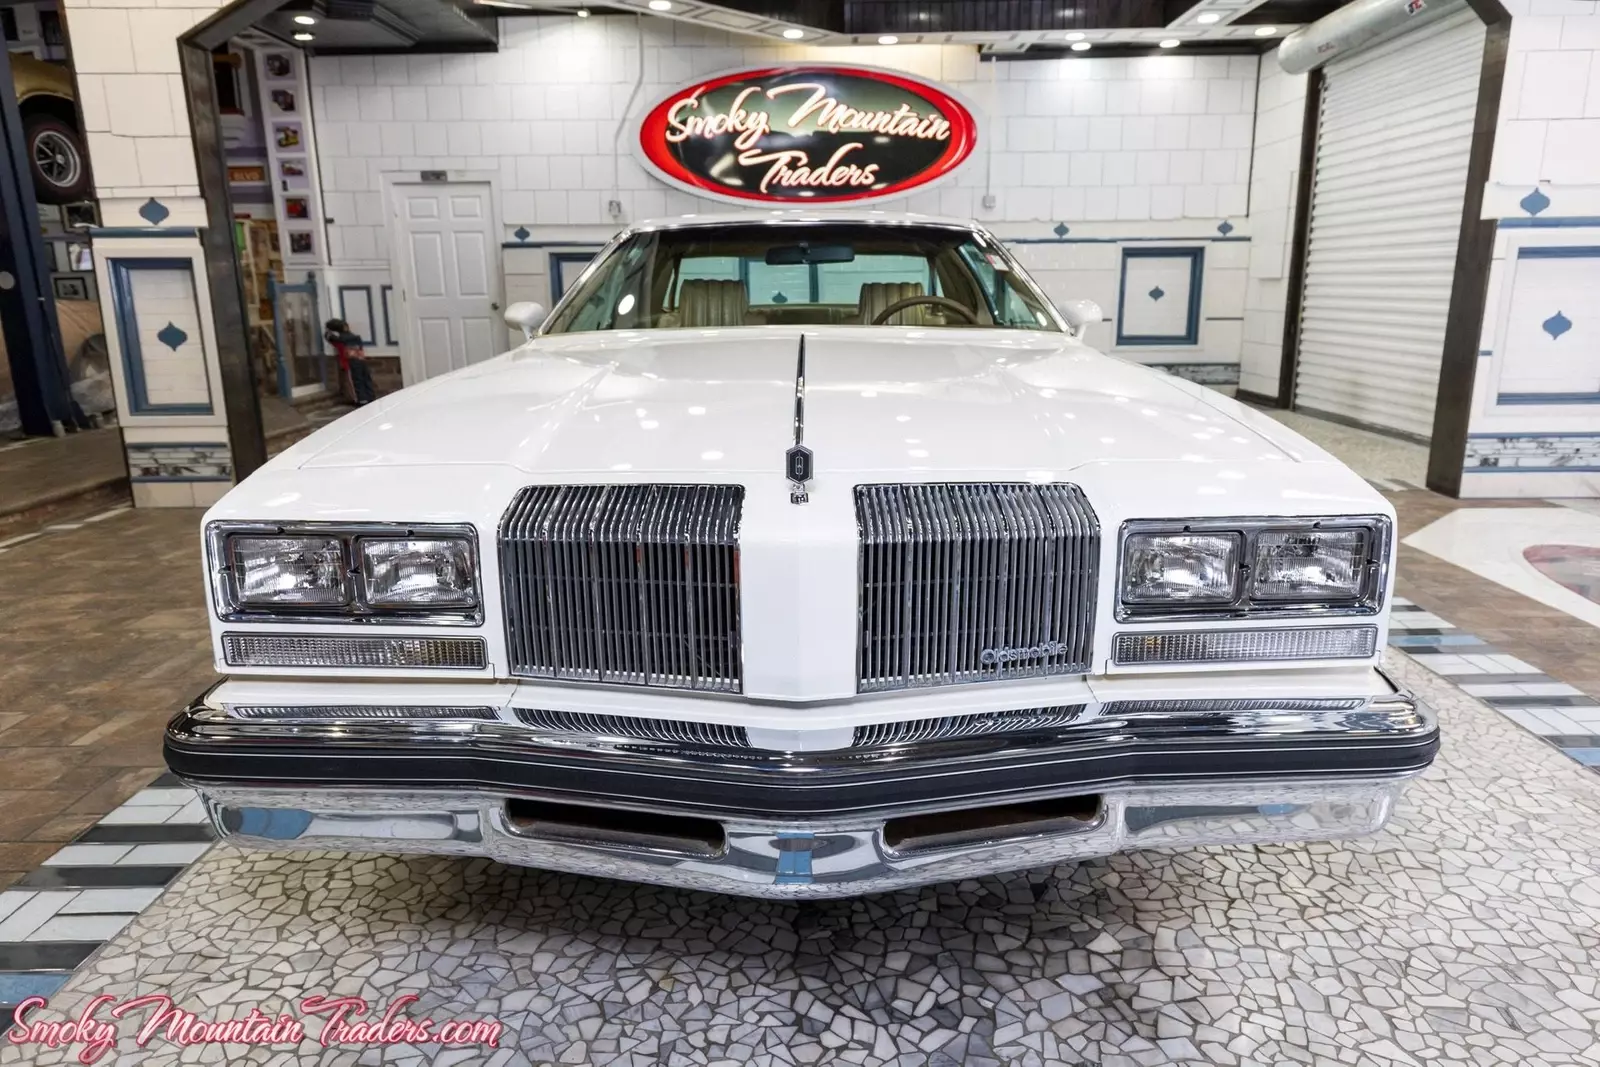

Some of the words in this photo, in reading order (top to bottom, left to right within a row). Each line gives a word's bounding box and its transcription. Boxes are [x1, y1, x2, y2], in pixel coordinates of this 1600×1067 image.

[665, 87, 769, 150] Smoky
[767, 83, 951, 141] Mountain
[738, 143, 880, 194] Traders
